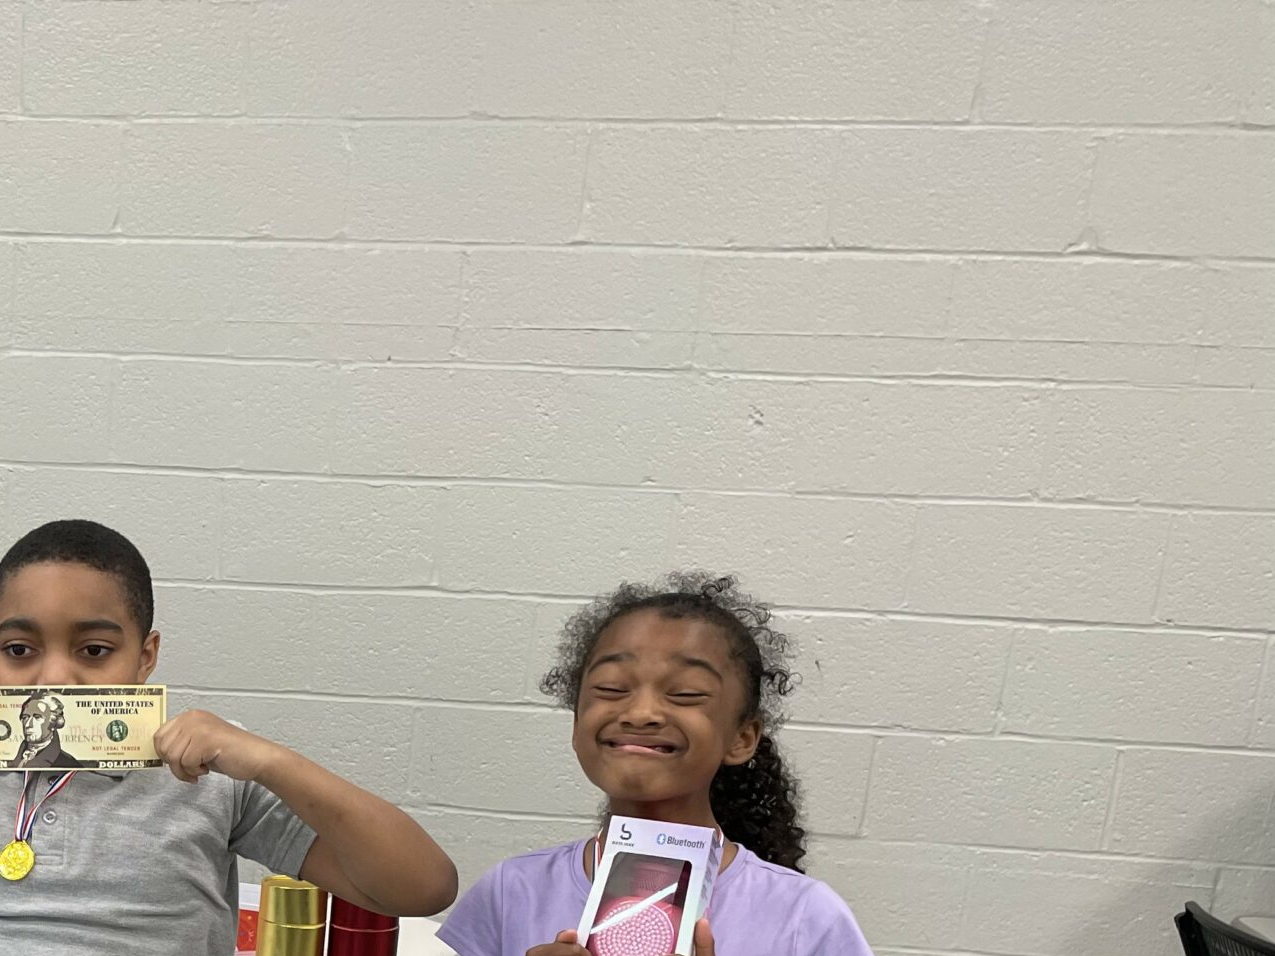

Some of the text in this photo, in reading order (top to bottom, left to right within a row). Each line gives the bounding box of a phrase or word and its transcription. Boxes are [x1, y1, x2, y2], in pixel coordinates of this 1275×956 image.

[94, 700, 124, 708] UNITED
[125, 700, 154, 708] STATES
[666, 836, 705, 849] Bluetooth
